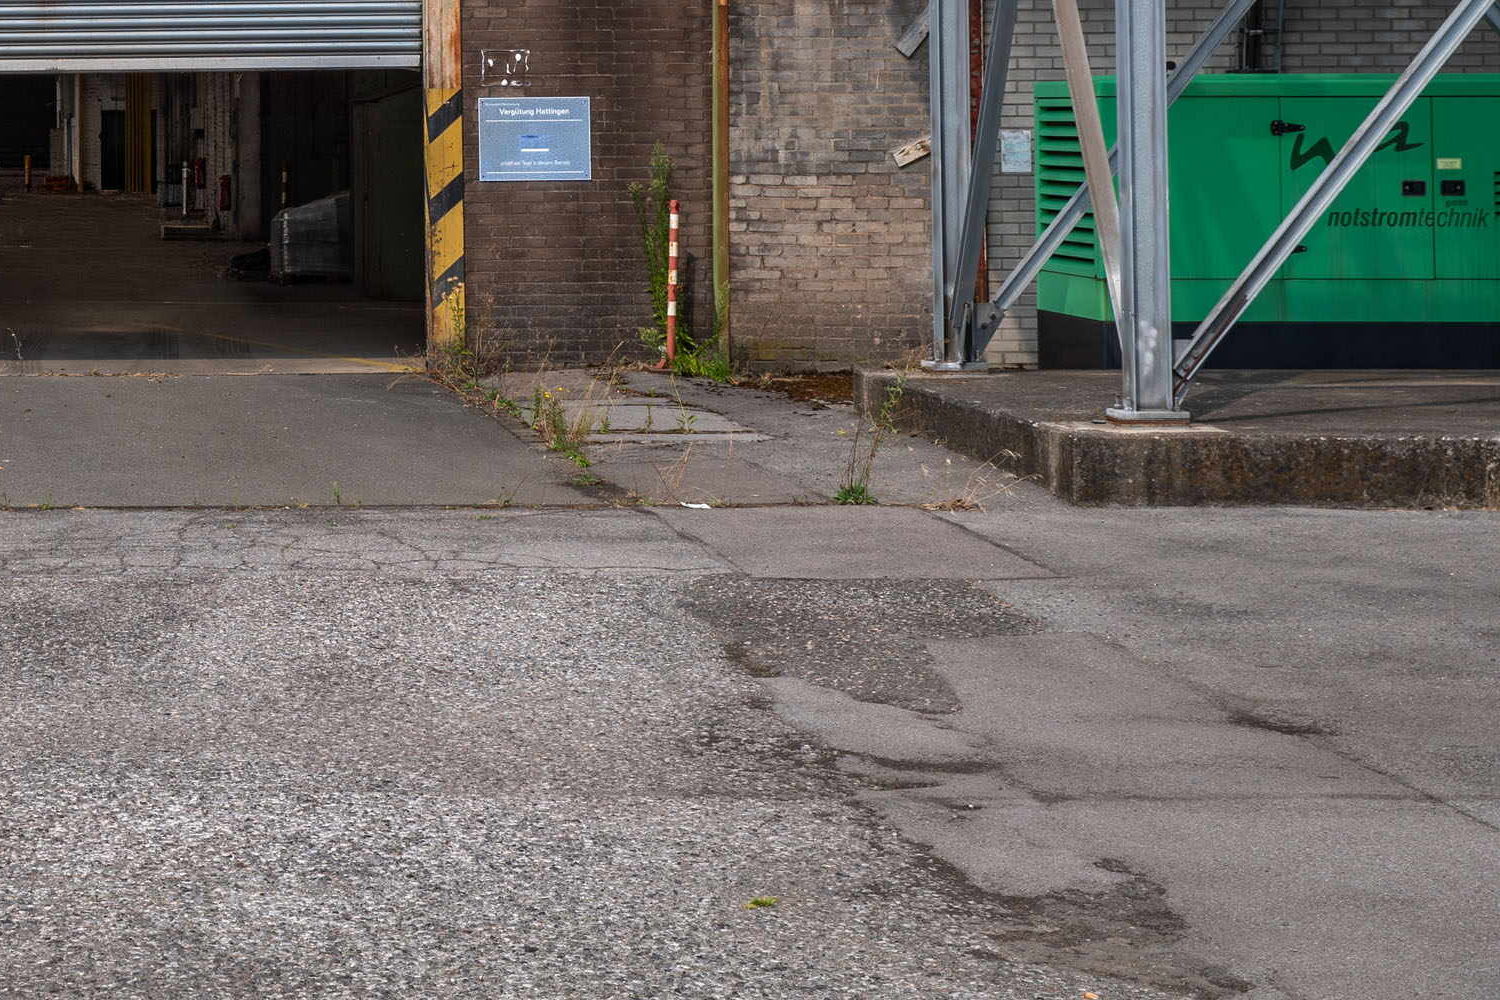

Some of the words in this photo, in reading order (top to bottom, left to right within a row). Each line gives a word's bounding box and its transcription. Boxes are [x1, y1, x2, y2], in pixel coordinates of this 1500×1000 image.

[499, 107, 534, 116] Vergütung
[535, 107, 570, 116] Hattingen
[1327, 207, 1491, 228] notstromtechnik
